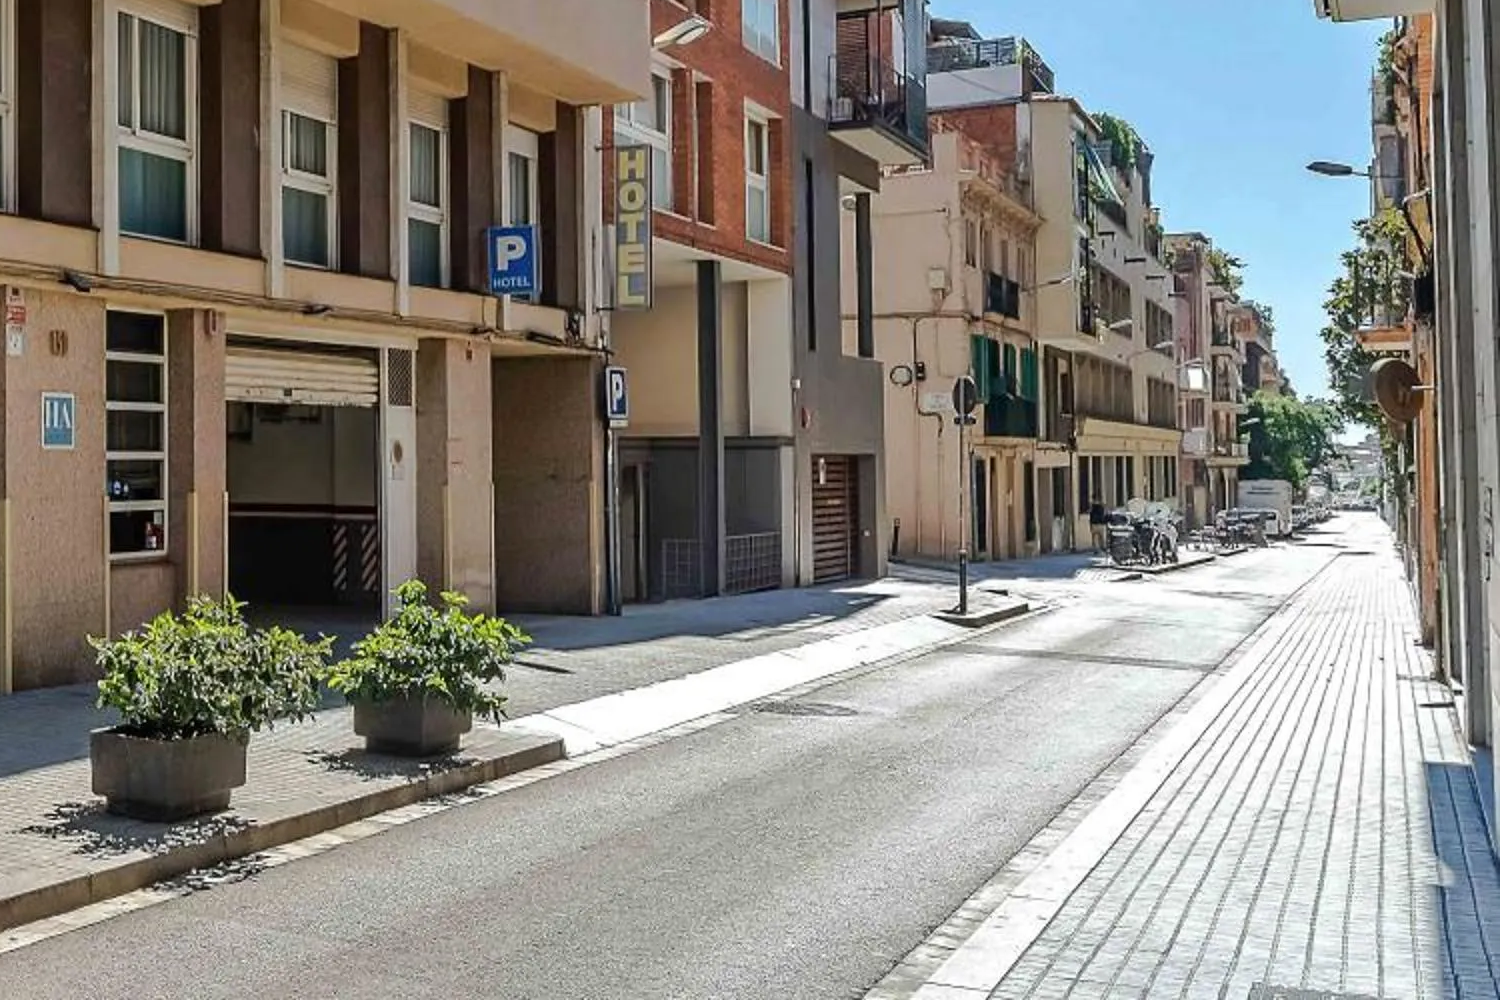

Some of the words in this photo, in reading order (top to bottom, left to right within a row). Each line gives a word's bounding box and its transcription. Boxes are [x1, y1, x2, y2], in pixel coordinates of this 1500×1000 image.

[618, 149, 646, 306] HOTEL
[496, 235, 527, 271] P
[493, 276, 531, 289] HOTEL
[610, 373, 624, 411] P
